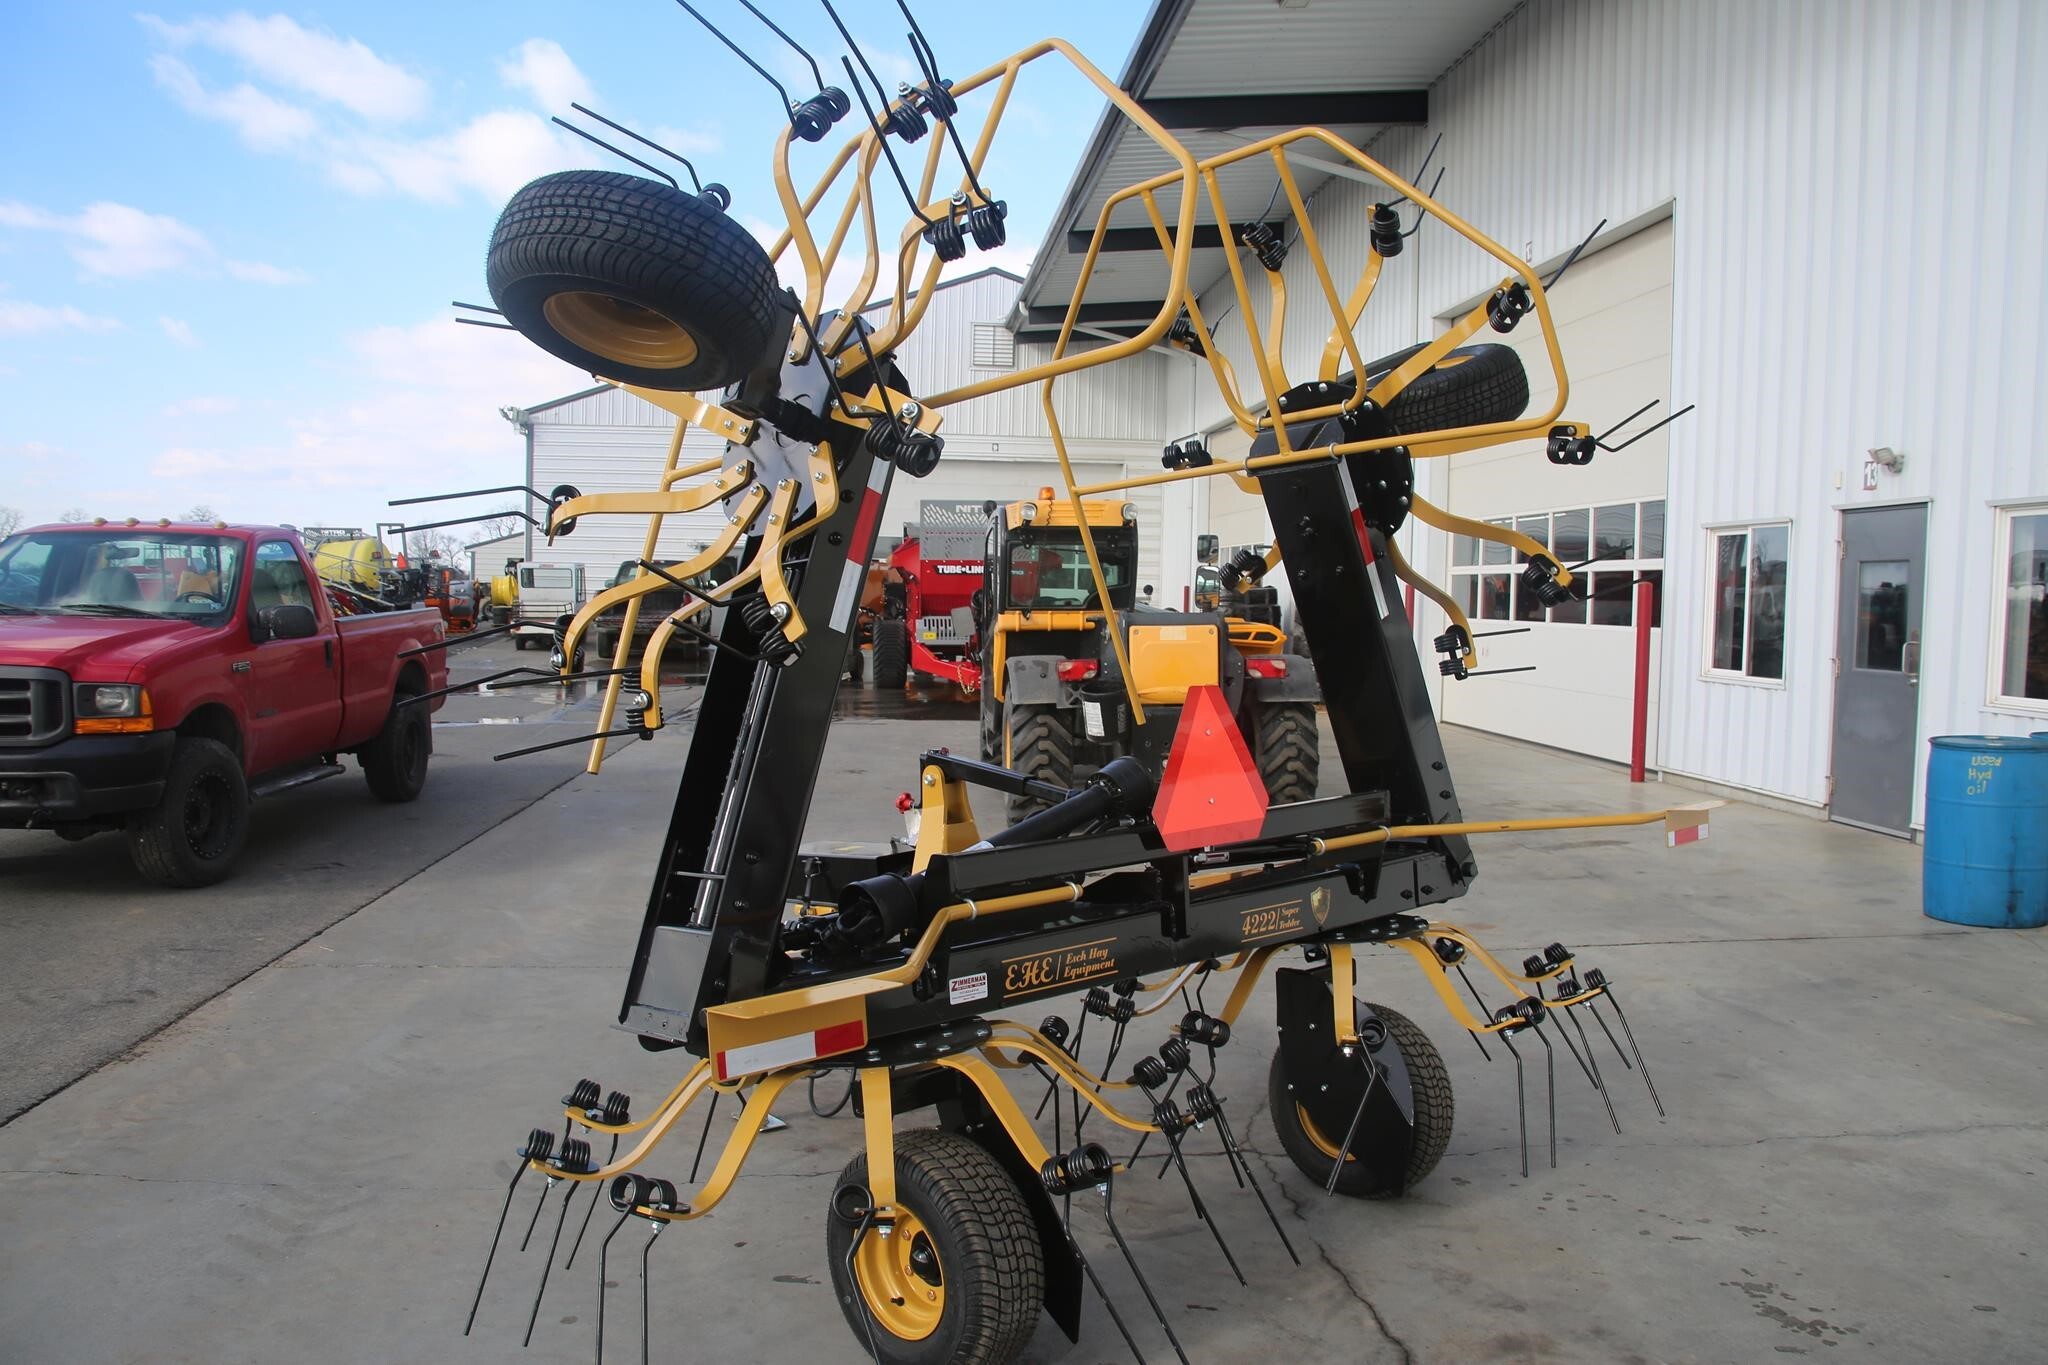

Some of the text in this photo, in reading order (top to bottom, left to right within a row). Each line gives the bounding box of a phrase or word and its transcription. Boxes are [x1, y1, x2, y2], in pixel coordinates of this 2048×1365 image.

[1968, 767, 1992, 784] Hyd
[1281, 907, 1299, 917] Super
[1242, 911, 1276, 935] 4222
[1066, 947, 1109, 964] Esch Hay
[1063, 958, 1115, 979] Equipment
[951, 975, 987, 992] ZIMMERMAN
